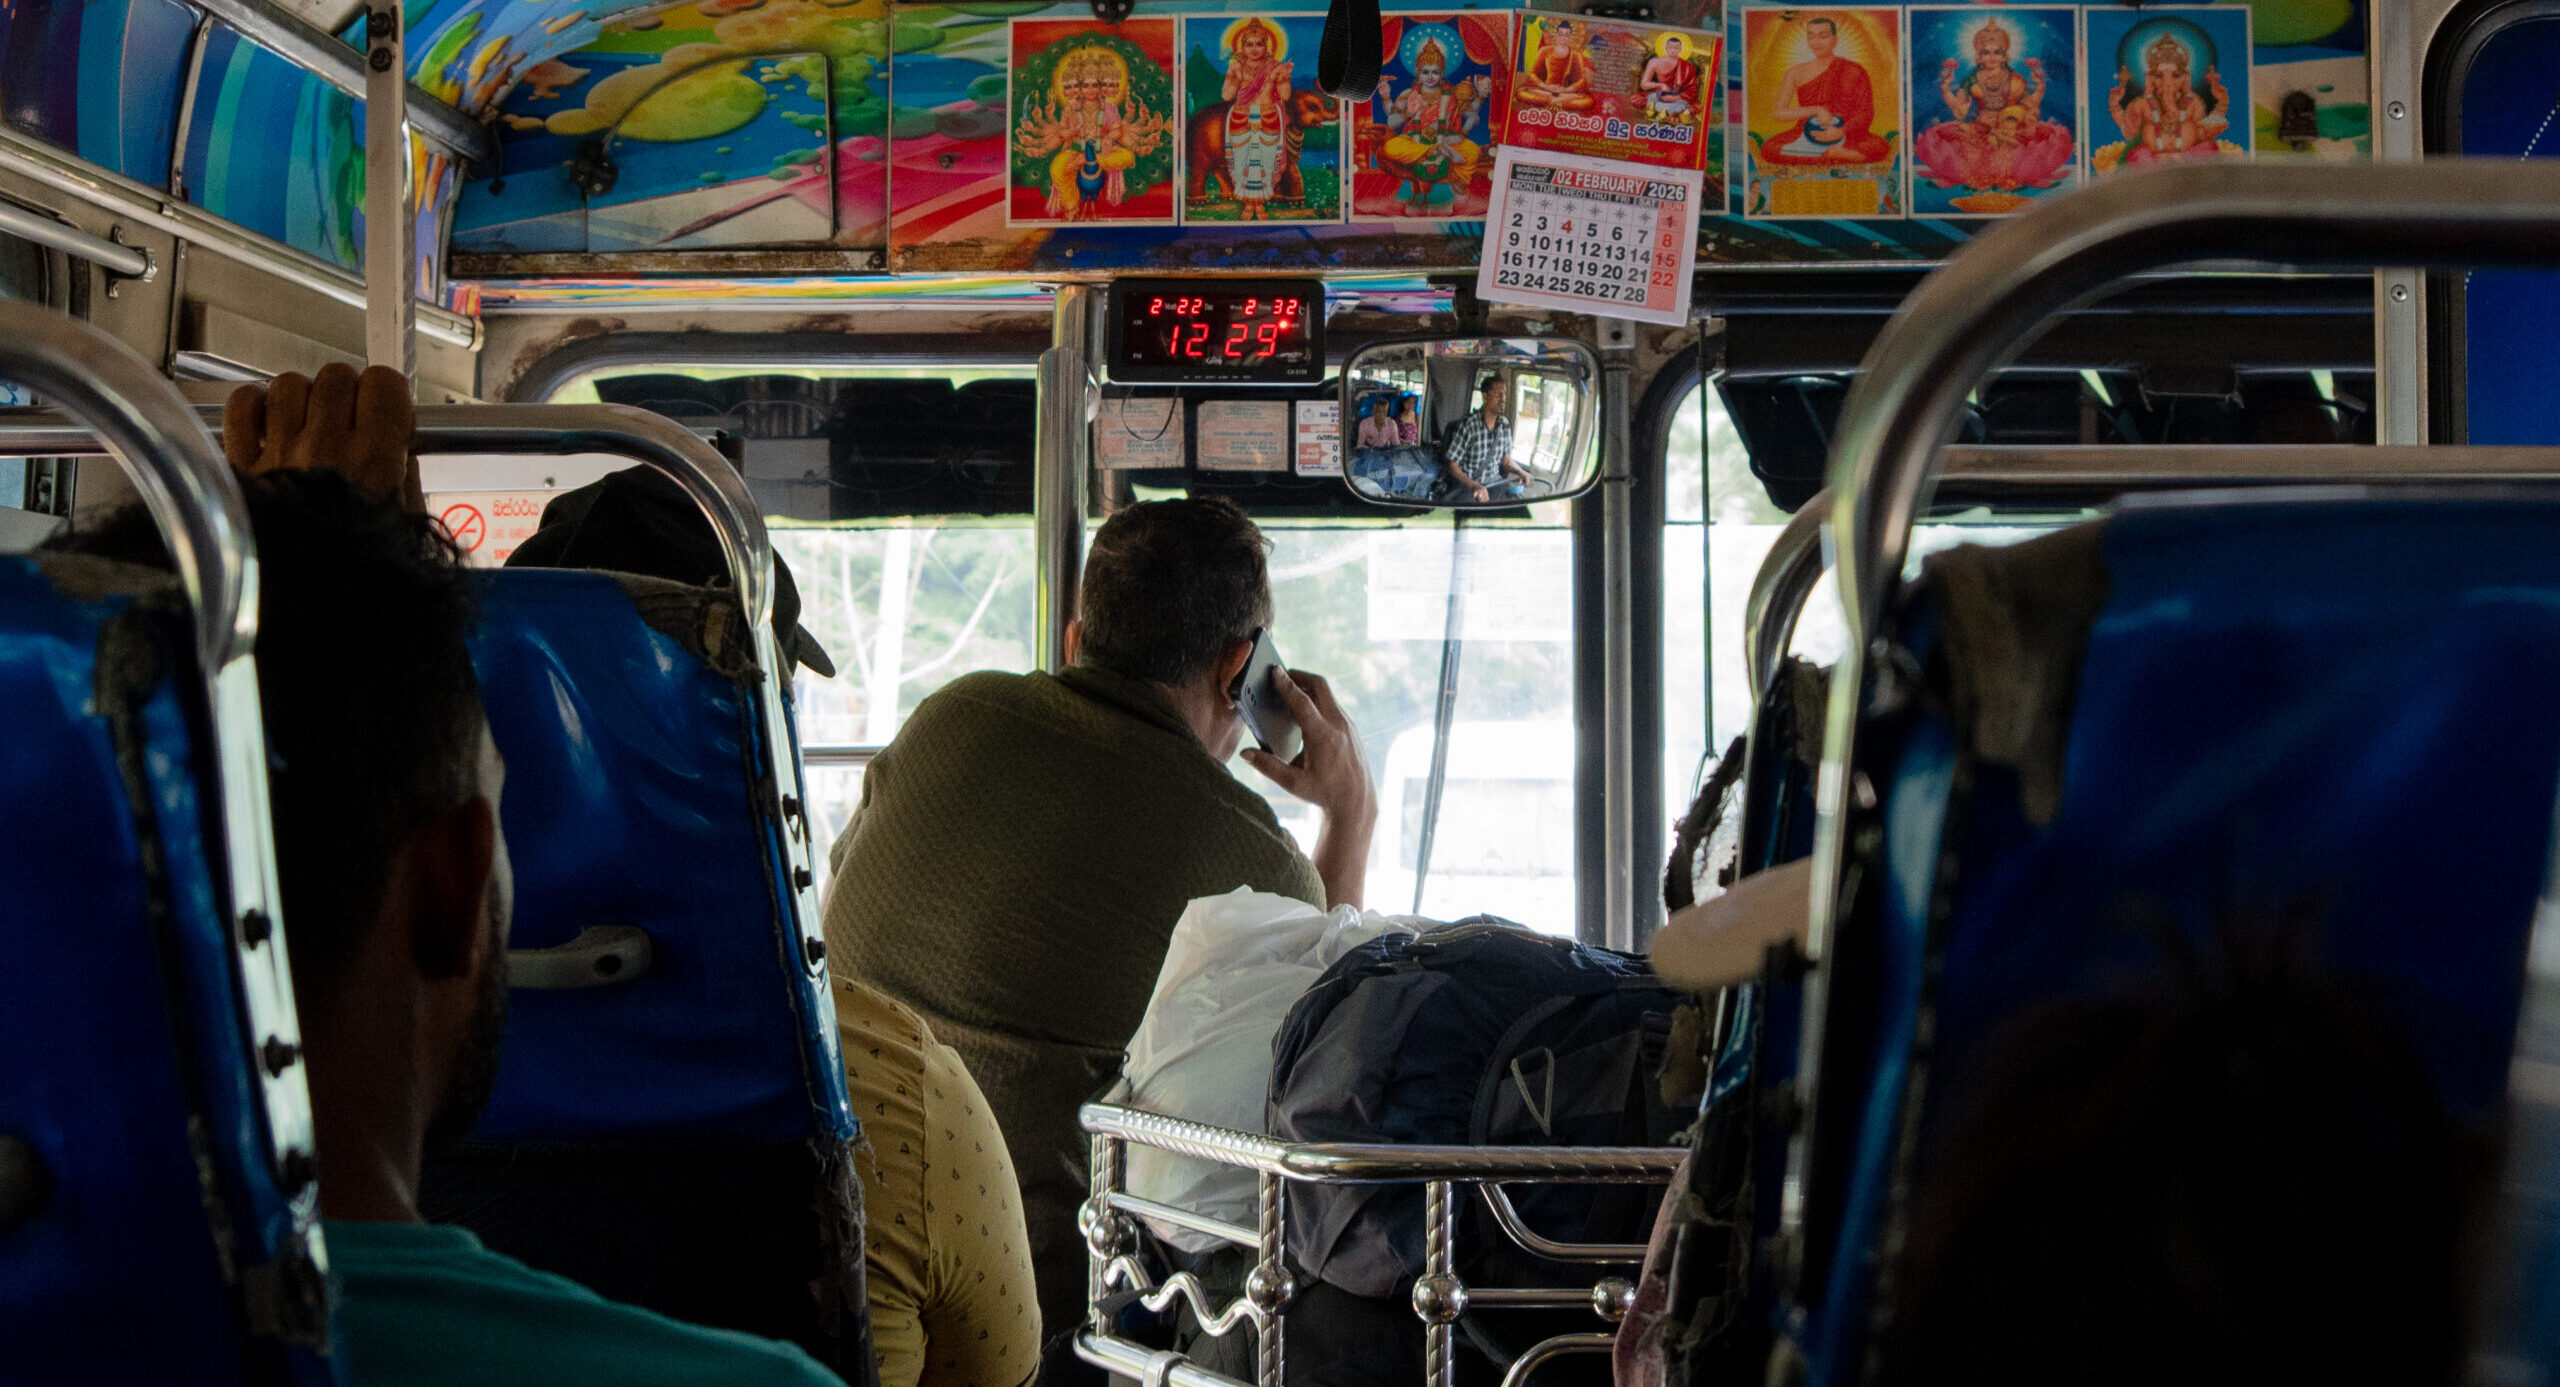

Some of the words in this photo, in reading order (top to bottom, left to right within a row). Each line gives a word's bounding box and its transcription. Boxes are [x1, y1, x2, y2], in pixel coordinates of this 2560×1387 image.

[1519, 109, 1551, 124] මෙම
[1555, 112, 1602, 132] නිවසට
[1512, 181, 1533, 191] MON
[1539, 184, 1556, 194] TUE
[1561, 187, 1583, 197] WED
[1589, 190, 1607, 200] THU
[1615, 195, 1631, 204] FRI
[1638, 198, 1656, 207] SAT
[1557, 169, 1573, 185] 02
[1575, 172, 1644, 194] FEBRUARY
[1647, 182, 1685, 201] 2026
[1511, 213, 1523, 227] 2
[1536, 216, 1548, 230] 3
[1561, 219, 1573, 234] 4
[1586, 223, 1598, 237] 5
[1611, 226, 1623, 240] 6
[1637, 230, 1648, 244] 7
[1662, 234, 1673, 248] 8
[1666, 215, 1674, 228] 1
[1509, 232, 1520, 246] 9
[1530, 235, 1550, 250] 10
[1555, 238, 1573, 254] 11
[1580, 242, 1601, 257] 12
[1605, 245, 1626, 261] 13
[1630, 249, 1650, 264] 14
[1656, 253, 1675, 267] 15
[1502, 250, 1522, 266] 16
[1527, 254, 1547, 270] 17
[1552, 257, 1572, 273] 18
[1577, 261, 1598, 276] 19
[1601, 264, 1623, 280] 20
[1627, 268, 1648, 283] 21
[1652, 271, 1673, 287] 22
[1498, 270, 1519, 286] 23
[1523, 273, 1544, 289] 24
[1548, 277, 1570, 292] 25
[1573, 280, 1595, 296] 26
[1598, 283, 1621, 299] 27
[1624, 287, 1646, 302] 28
[1151, 298, 1162, 314] 2
[1177, 298, 1202, 314] 22
[1245, 299, 1256, 315] 2
[1273, 299, 1297, 315] 32
[1169, 323, 1209, 357] 12
[1224, 323, 1278, 357] 29
